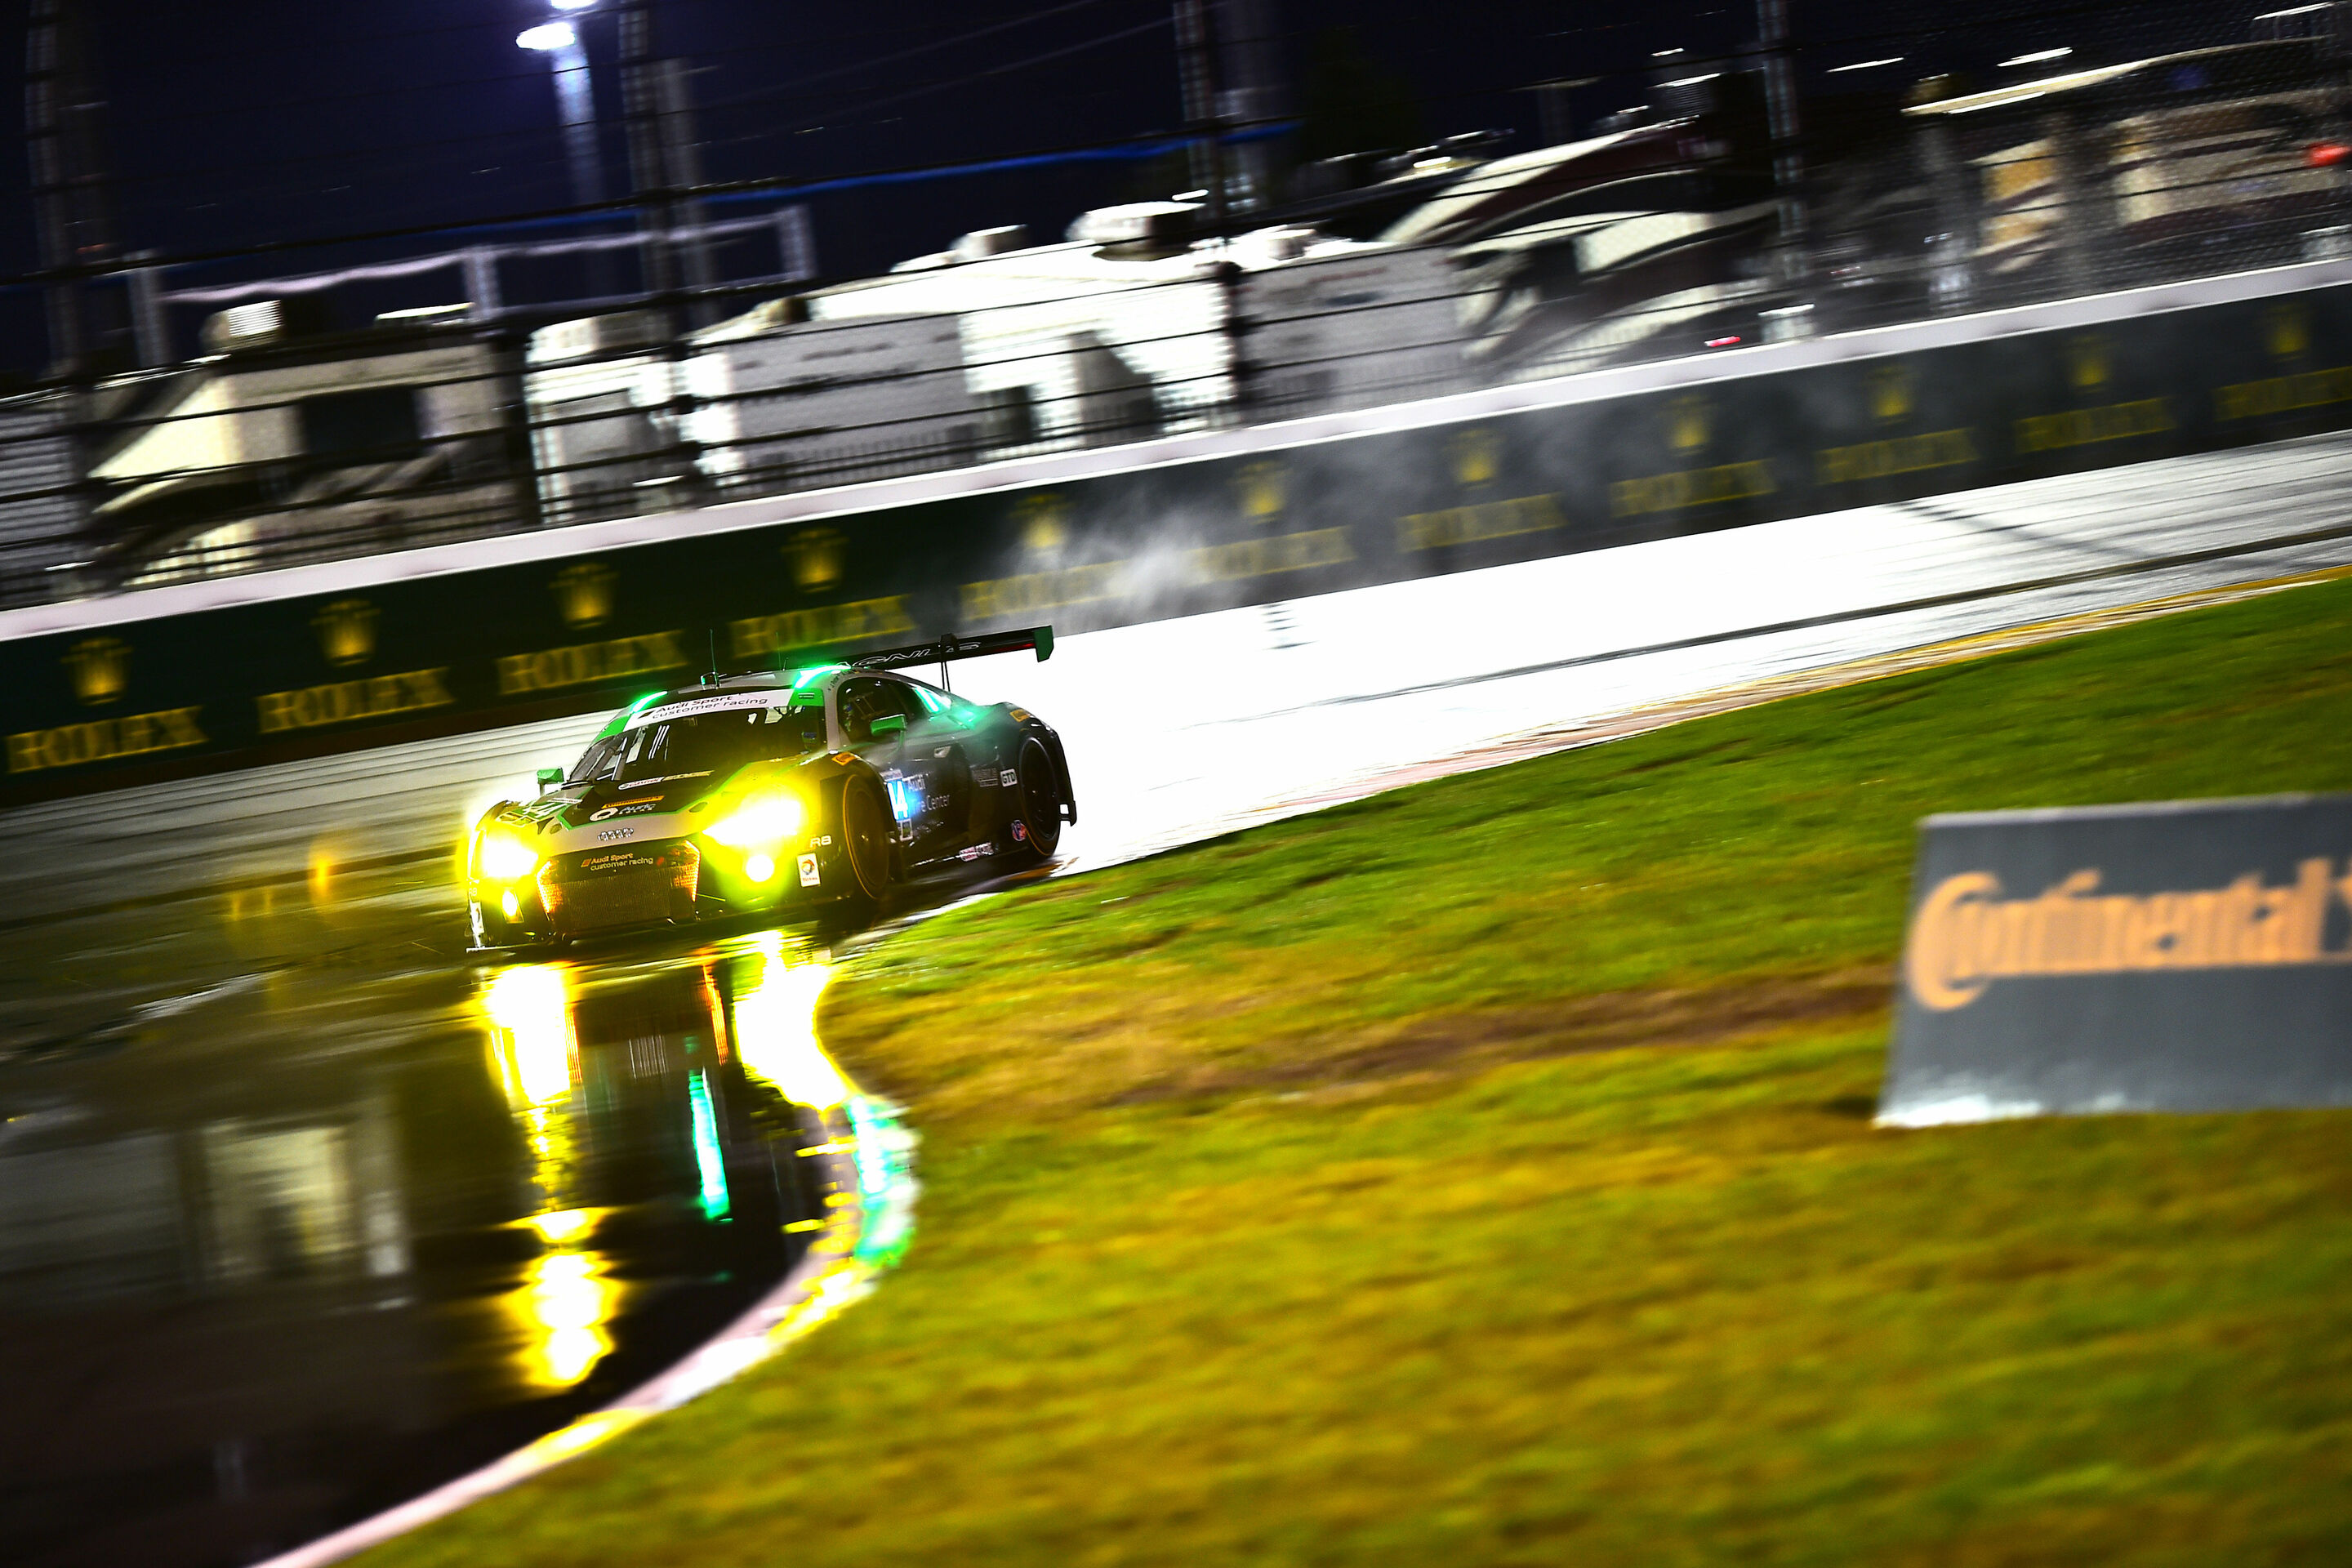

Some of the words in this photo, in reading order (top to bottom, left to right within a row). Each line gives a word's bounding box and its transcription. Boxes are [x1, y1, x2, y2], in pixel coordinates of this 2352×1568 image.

[730, 594, 916, 657] ROLEX
[497, 629, 688, 695] ROLEX
[255, 666, 456, 733] ROLEX
[652, 702, 720, 719] customer
[723, 697, 768, 708] racing
[655, 702, 689, 713] Audi
[693, 695, 733, 706] Sport
[7, 706, 208, 774] ROLEX
[1002, 772, 1016, 784] GTD
[809, 835, 831, 848] R8
[590, 855, 609, 865] Audi
[610, 853, 634, 862] Sport
[590, 860, 627, 871] customer
[629, 858, 653, 867] racing
